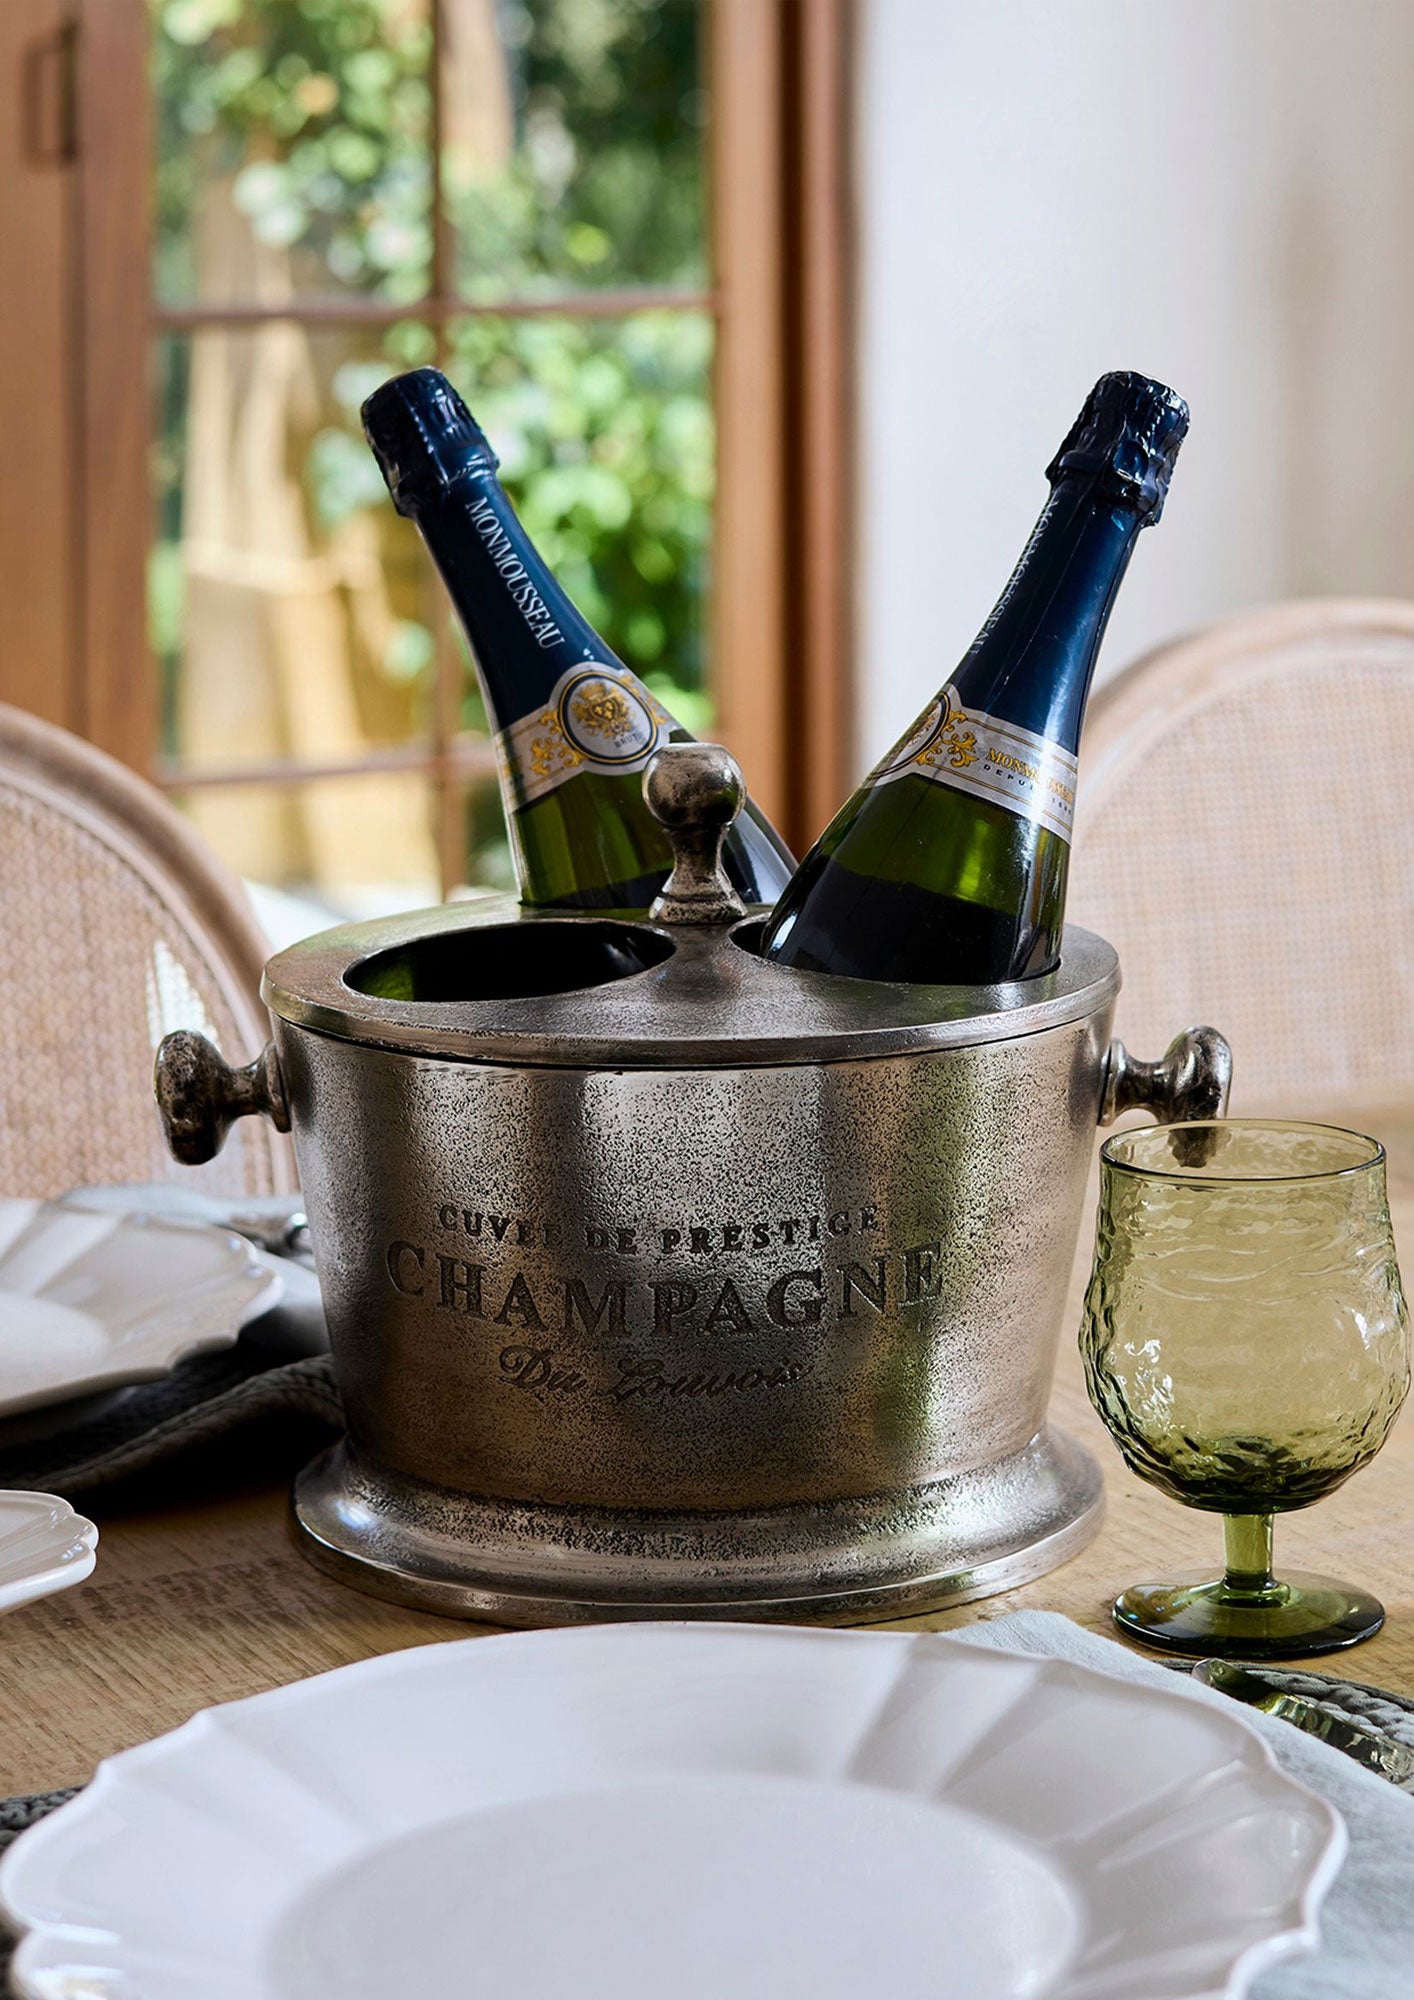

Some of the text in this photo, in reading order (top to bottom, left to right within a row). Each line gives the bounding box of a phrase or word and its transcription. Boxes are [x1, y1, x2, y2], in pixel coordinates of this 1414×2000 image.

[465, 496, 565, 649] MONMOUSSEAU
[585, 1225, 637, 1255] DE
[661, 1205, 879, 1254] PRESTIGE
[384, 1240, 943, 1339] CHAMPAGNE
